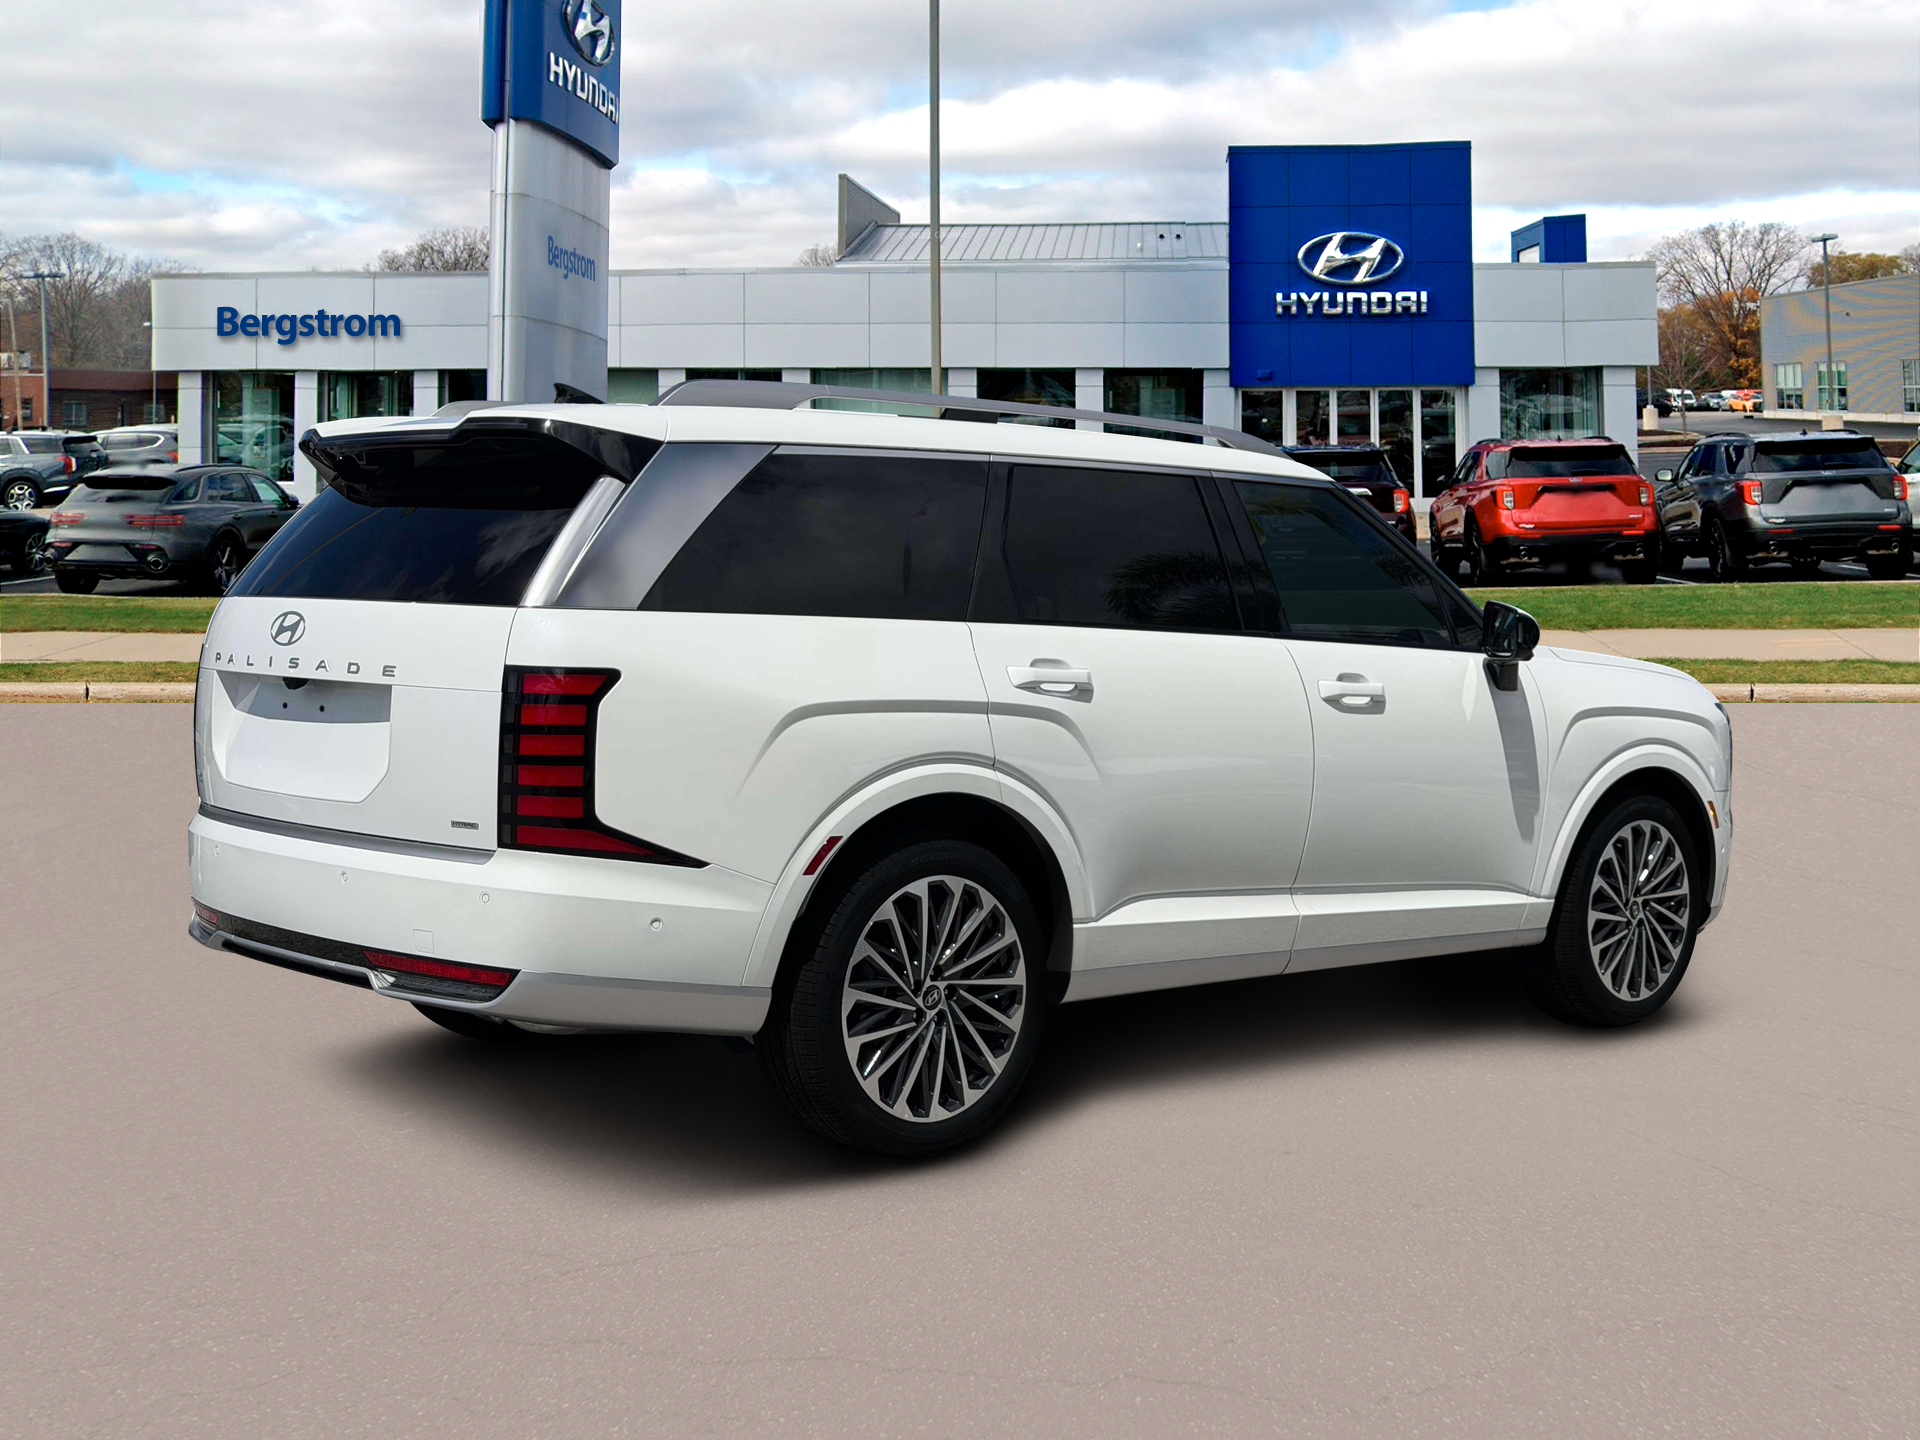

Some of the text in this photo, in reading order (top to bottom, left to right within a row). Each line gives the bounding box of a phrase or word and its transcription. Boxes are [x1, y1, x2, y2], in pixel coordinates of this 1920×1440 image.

[548, 51, 619, 124] HYUNDAI
[548, 235, 596, 282] Bergstrom
[1275, 291, 1428, 315] HYUNDAI
[216, 306, 402, 346] Bergstrom
[215, 652, 397, 678] PALISADE
[452, 820, 478, 828] HTRAC
